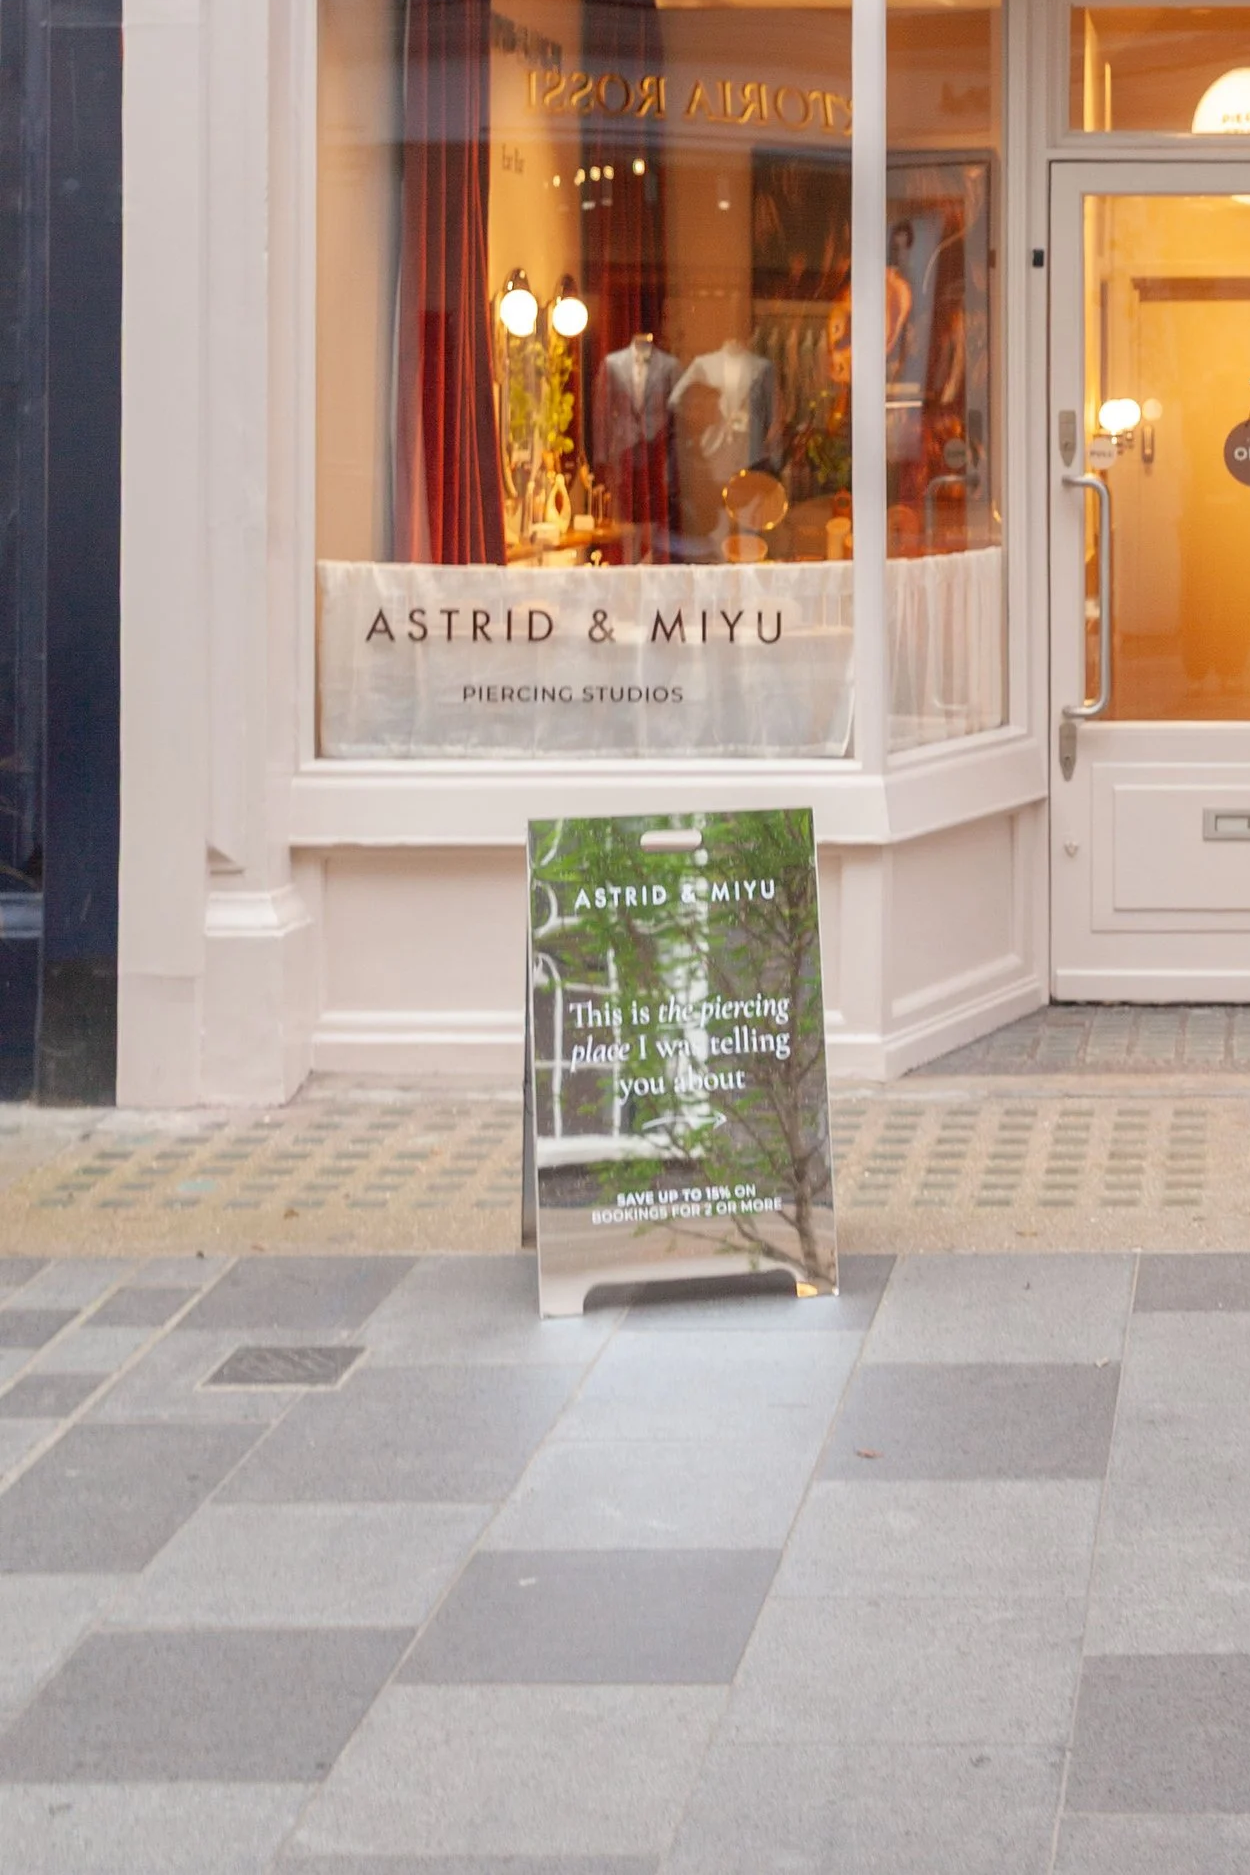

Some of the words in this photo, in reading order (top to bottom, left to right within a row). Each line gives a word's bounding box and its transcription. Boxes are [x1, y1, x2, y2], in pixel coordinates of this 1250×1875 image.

[365, 608, 554, 643] ASTRID
[587, 609, 615, 643] &
[651, 608, 784, 644] MIYU
[462, 685, 574, 703] PIERCING
[581, 685, 684, 703] STUDIOS
[574, 884, 667, 909] ASTRID
[711, 879, 775, 902] MIYU
[569, 999, 622, 1029] This
[631, 1000, 650, 1025] is
[658, 995, 694, 1024] the
[699, 992, 790, 1027] piercing
[570, 1034, 631, 1073] place
[639, 1034, 647, 1060] I
[710, 1025, 790, 1061] telling
[618, 1075, 665, 1106] you
[673, 1064, 746, 1094] about
[591, 1205, 668, 1225] BOOKINGS
[672, 1203, 701, 1219] FOR
[704, 1202, 713, 1217] 2
[716, 1199, 737, 1215] OR
[741, 1196, 782, 1213] MORE
[616, 1191, 654, 1208] SAVE
[658, 1189, 679, 1204] UP
[682, 1188, 702, 1202] TO
[705, 1185, 731, 1201] 15%
[734, 1183, 756, 1199] ON
